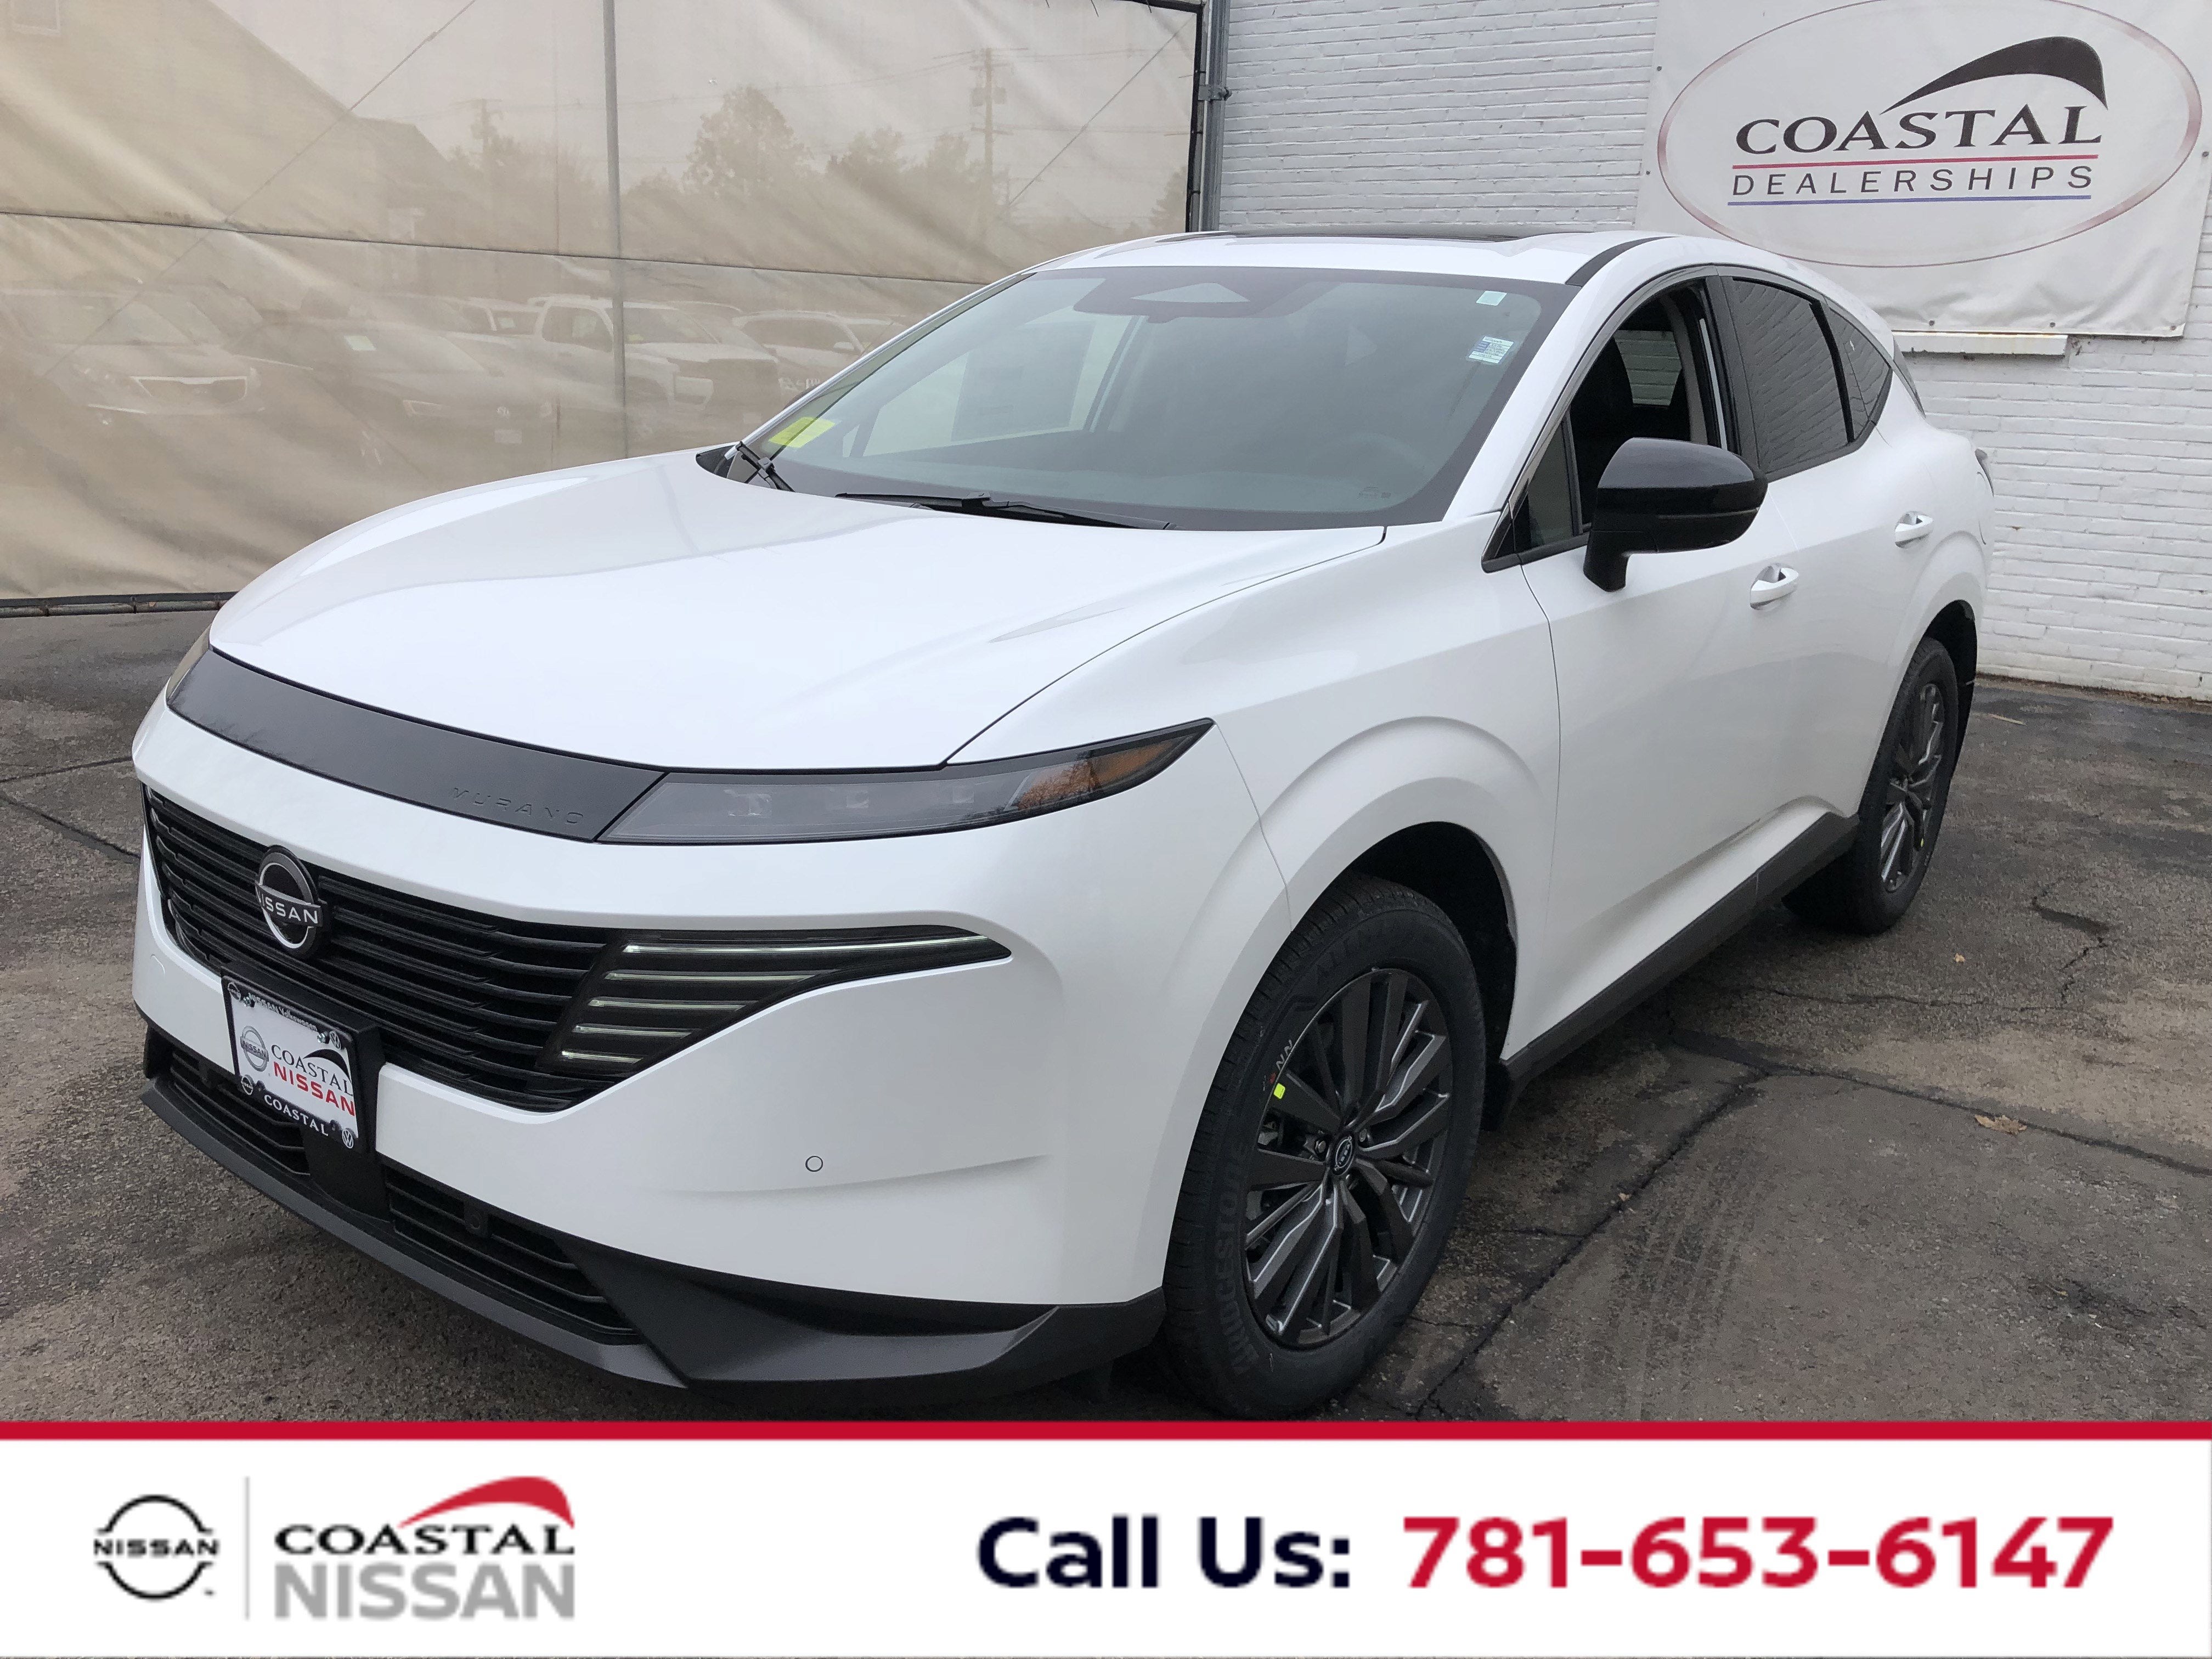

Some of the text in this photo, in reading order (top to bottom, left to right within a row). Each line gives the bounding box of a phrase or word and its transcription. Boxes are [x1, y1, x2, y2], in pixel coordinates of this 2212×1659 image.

[1735, 103, 2103, 155] COASTAL
[1733, 165, 2093, 196] DEALERSHIPS
[255, 885, 319, 924] NISSAN
[271, 1044, 353, 1097] COASTAL
[273, 1061, 356, 1116] NISSAN
[264, 1094, 329, 1137] COASTAL
